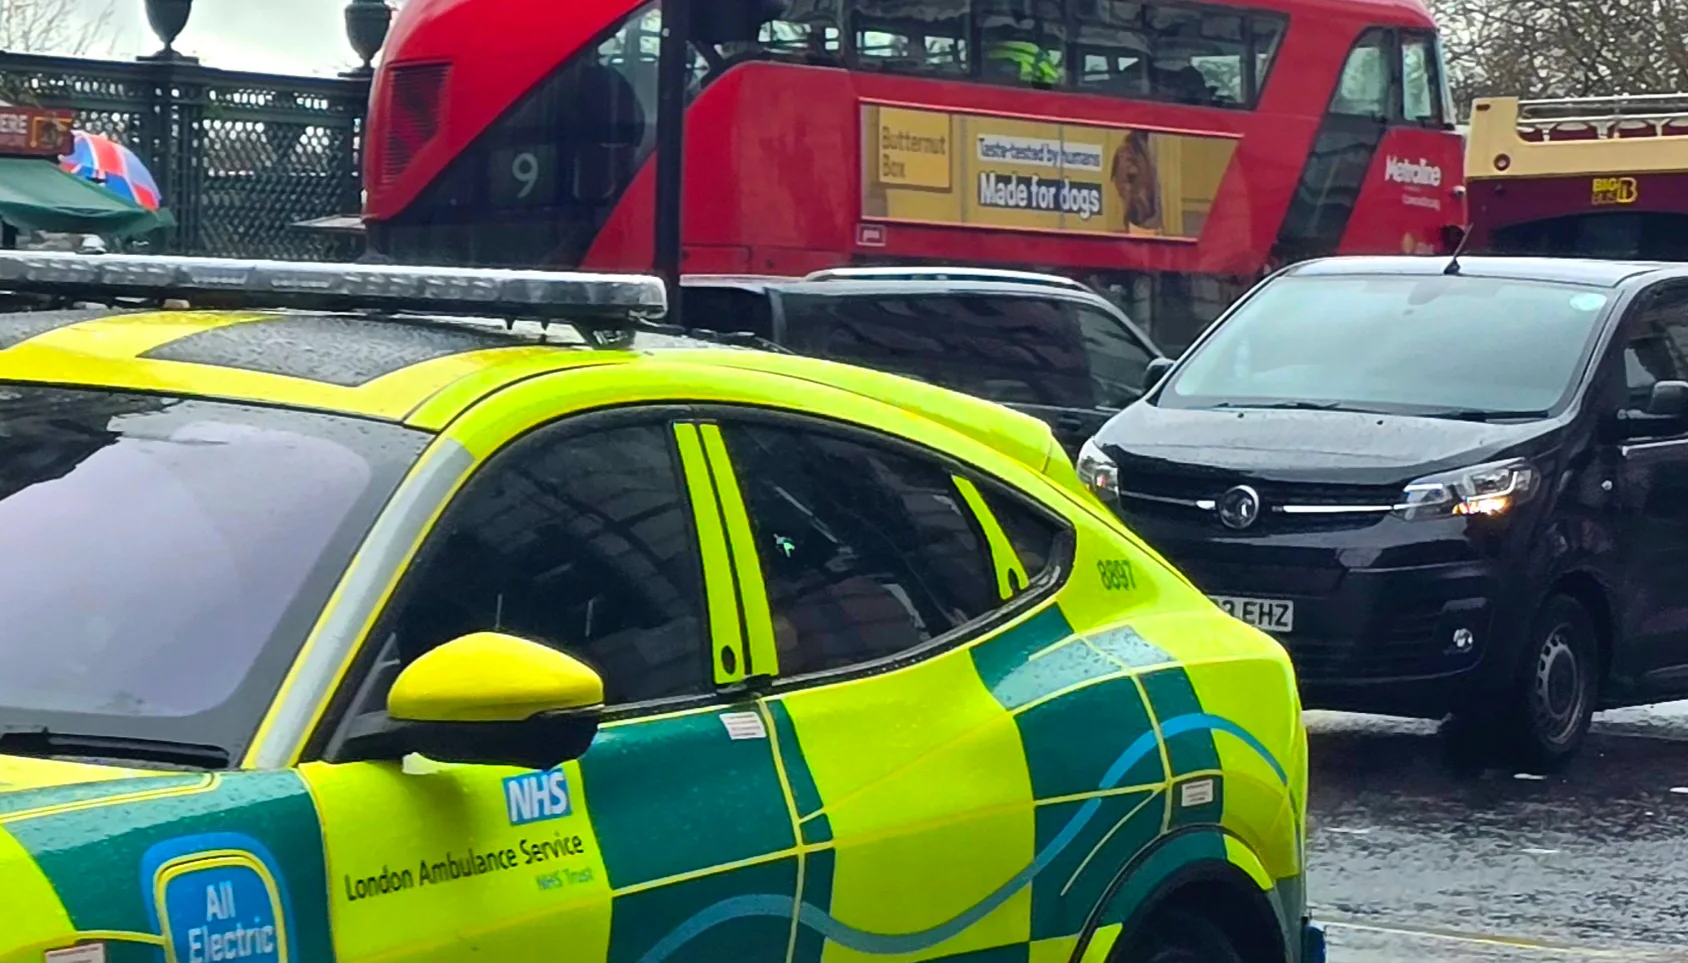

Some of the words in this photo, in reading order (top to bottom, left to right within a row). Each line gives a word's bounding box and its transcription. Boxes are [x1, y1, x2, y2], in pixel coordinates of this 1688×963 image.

[883, 126, 947, 155] Butternut
[512, 152, 538, 199] 9
[883, 154, 906, 178] Box
[1384, 154, 1442, 187] Metroline
[980, 172, 1028, 208] Made
[1030, 175, 1057, 209] for
[1059, 178, 1101, 219] dogs
[1097, 560, 1136, 591] 8897
[1242, 601, 1289, 627] EHZ
[509, 771, 568, 822] NHS
[344, 864, 413, 901] London
[419, 847, 518, 887] Ambulance
[519, 831, 584, 865] Service
[536, 869, 564, 892] NHS
[562, 866, 595, 886] Trust
[206, 880, 236, 922] All
